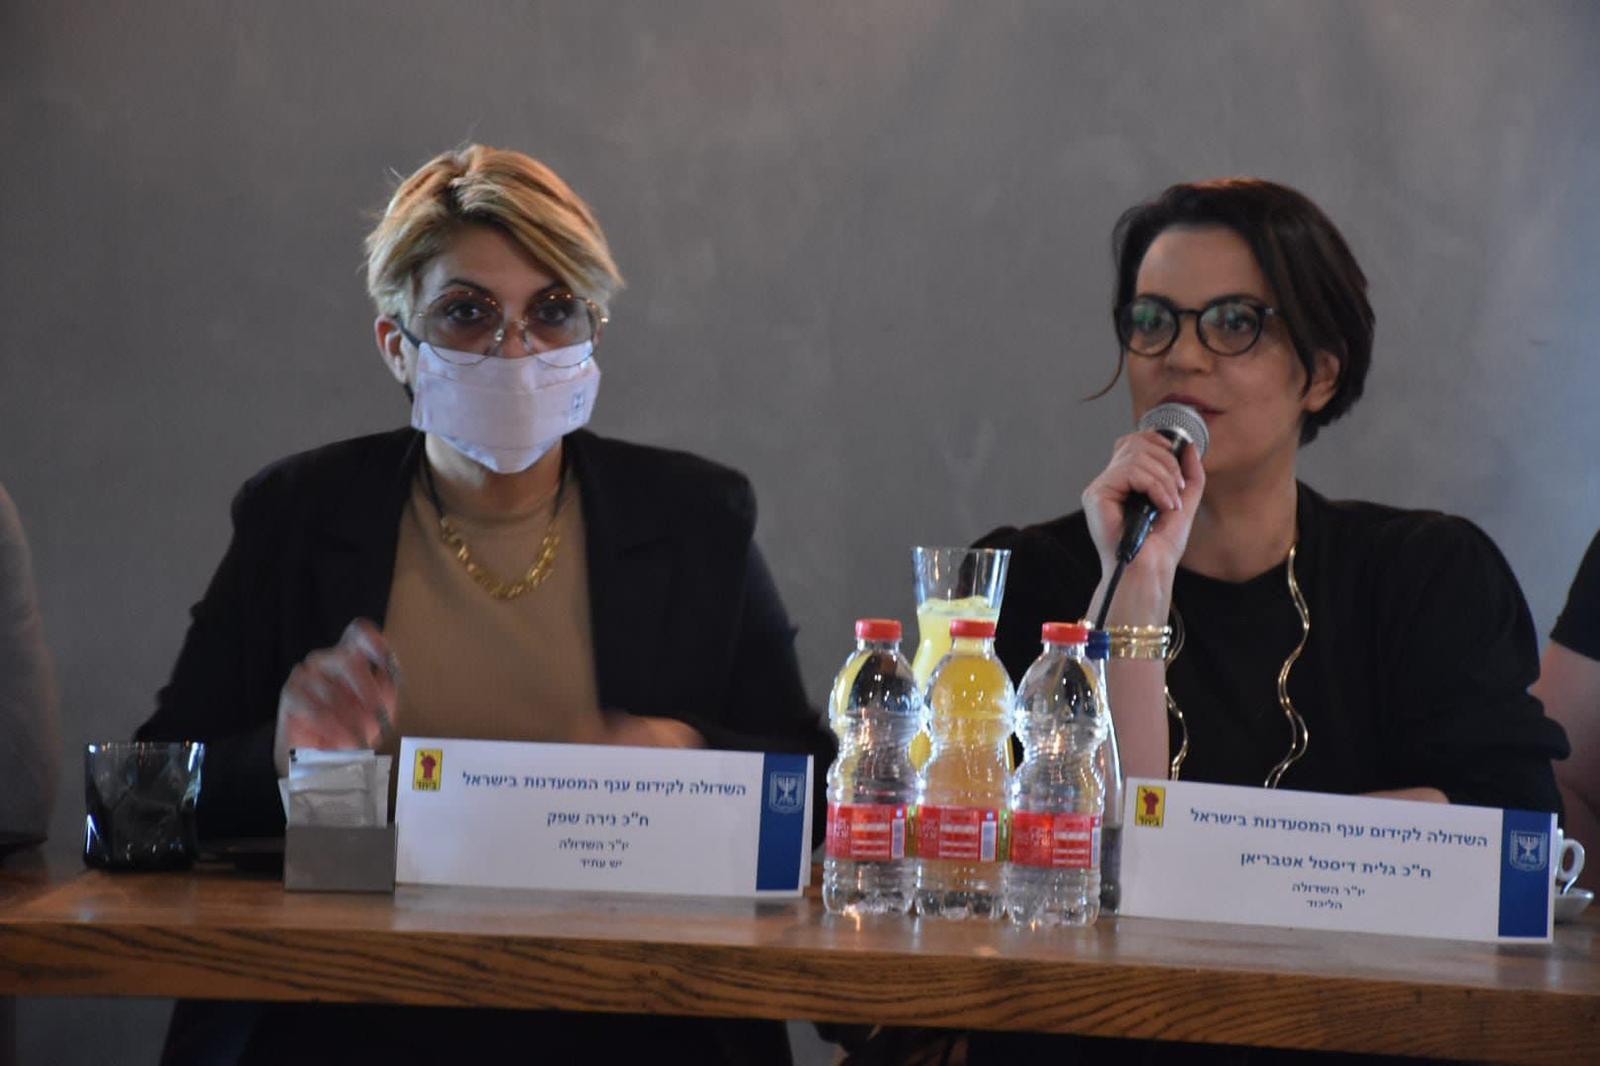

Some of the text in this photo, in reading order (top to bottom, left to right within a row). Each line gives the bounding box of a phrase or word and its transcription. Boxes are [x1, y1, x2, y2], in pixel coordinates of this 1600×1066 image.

[462, 771, 747, 797] השדולה לקידום ענף המסעדנות בישראל
[547, 811, 649, 827] ח"כ נירה שפק
[1190, 807, 1489, 848] השדולה לקידום ענף המסעדנות בישראל
[559, 837, 605, 851] השדולה
[580, 858, 623, 869] יש עתיד
[1240, 852, 1432, 879] ח"כ גלית דיסטל אטבריאן
[1291, 880, 1340, 897] השדולה
[1305, 898, 1344, 910] הליכוד
